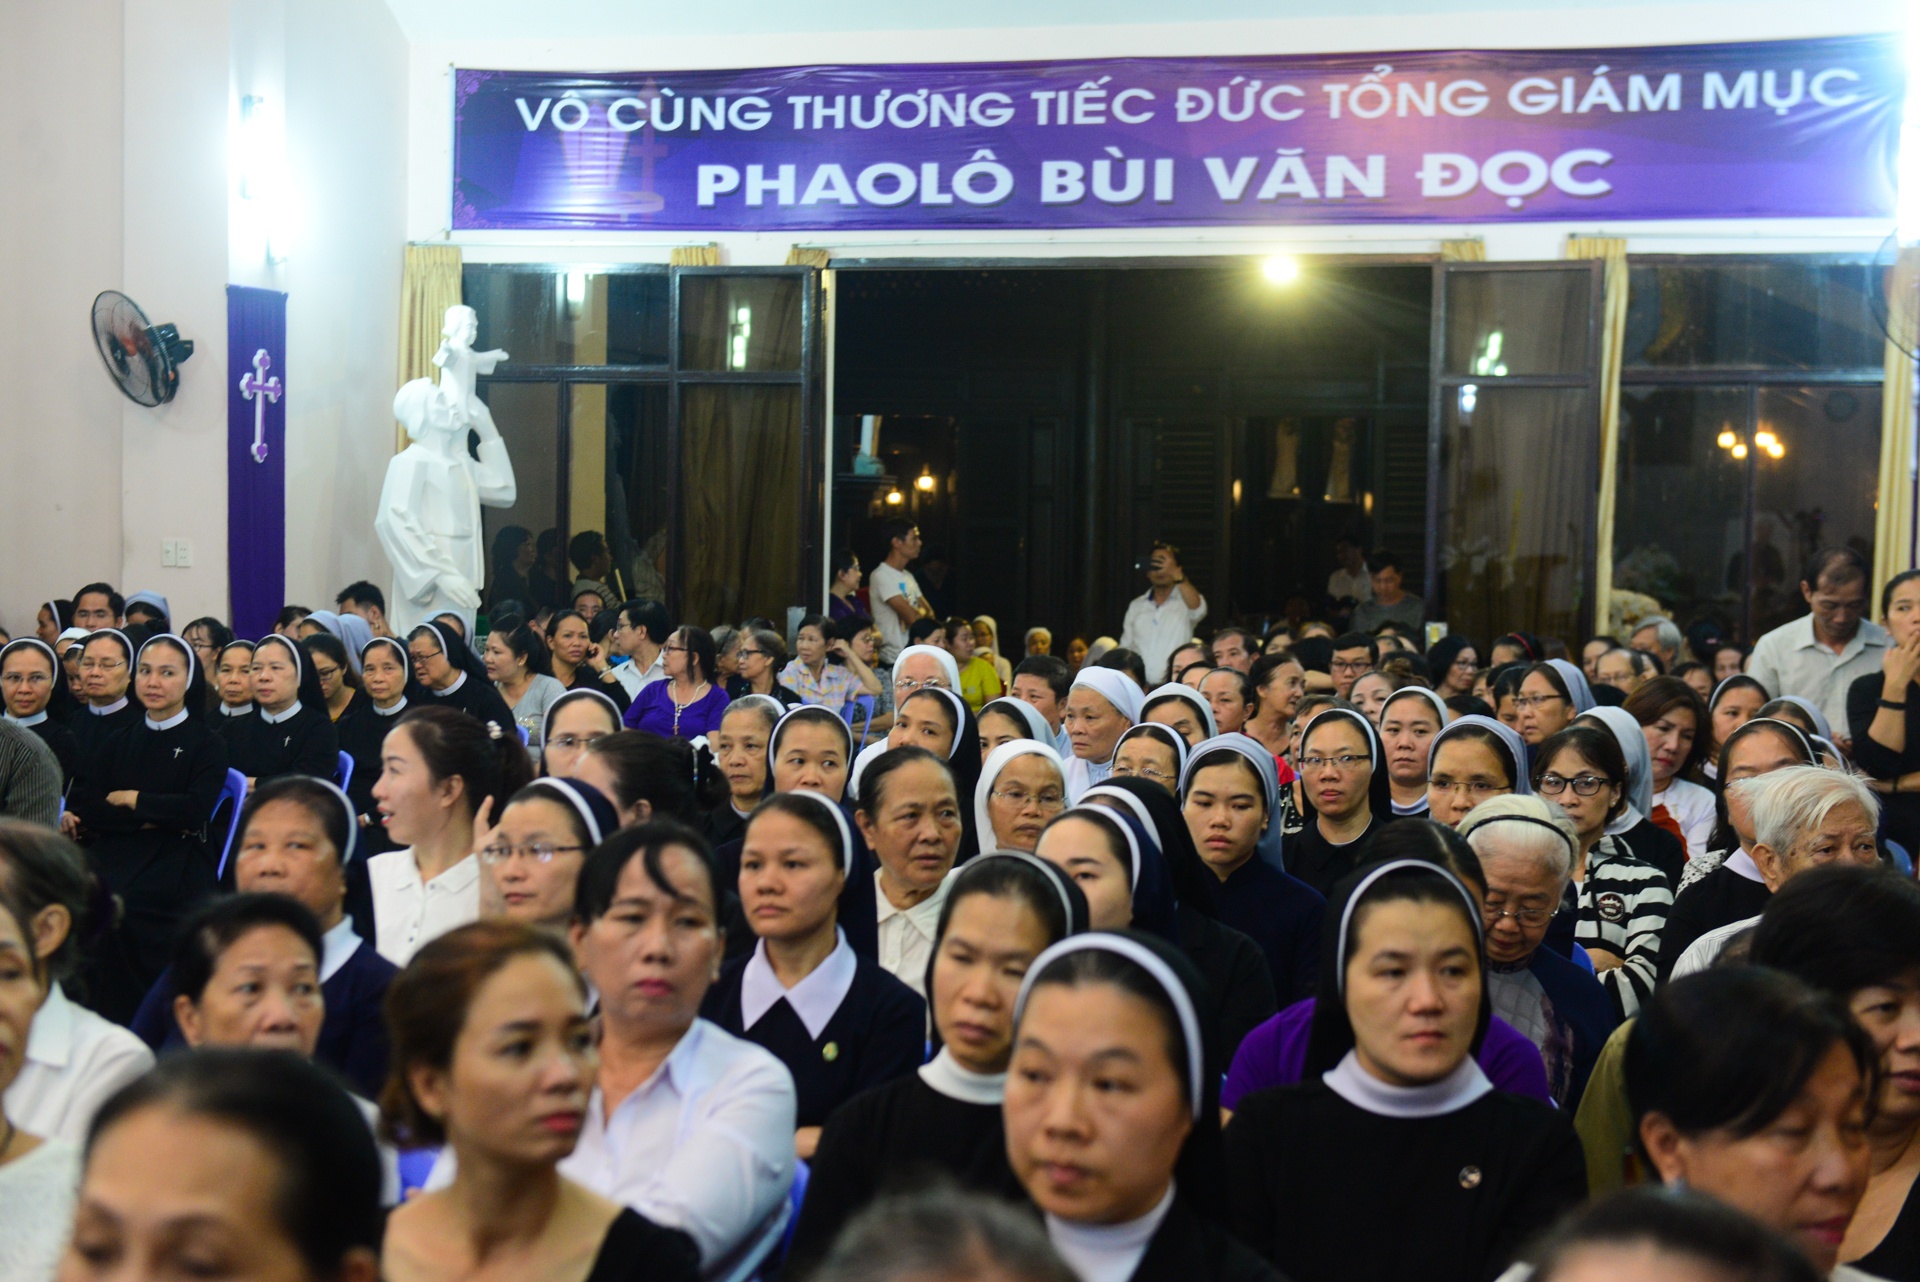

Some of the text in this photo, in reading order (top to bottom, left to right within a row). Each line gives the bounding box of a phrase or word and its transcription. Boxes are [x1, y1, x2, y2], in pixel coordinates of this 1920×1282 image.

[515, 65, 1862, 133] VÔ CÙNG THƯƠNG TIẾC ĐỨC TỔNG GIÁM MỤC
[697, 146, 1612, 208] PHAOLÔ BÙI VĂN ĐỌC
